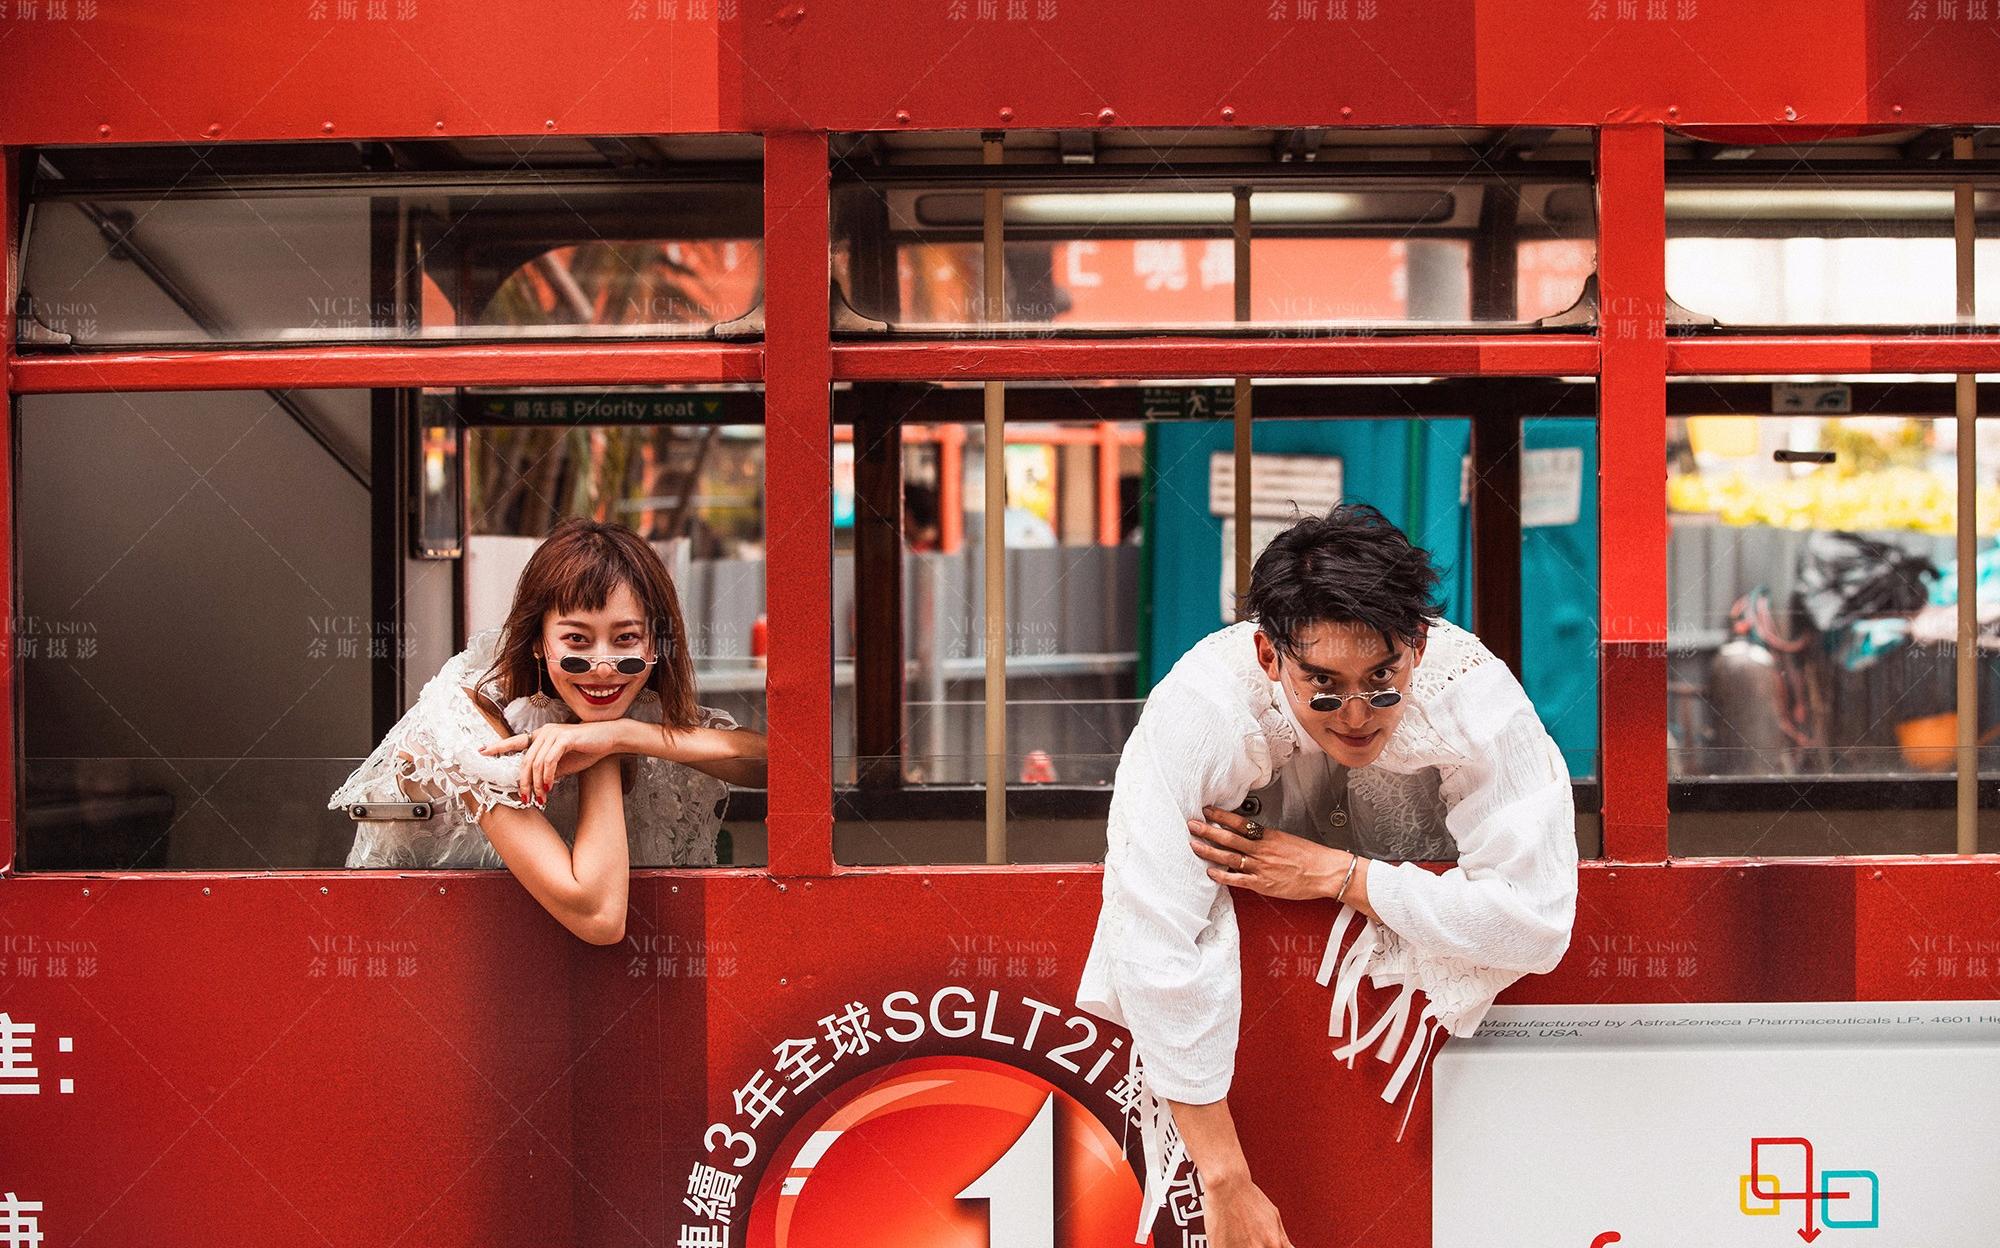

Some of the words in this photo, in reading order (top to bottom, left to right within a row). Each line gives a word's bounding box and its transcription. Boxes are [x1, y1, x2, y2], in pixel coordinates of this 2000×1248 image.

[574, 400, 647, 419] Priority
[653, 402, 695, 417] seat
[1479, 1019, 1600, 1028] Manufactured
[1605, 1019, 1631, 1028] by
[1630, 1018, 1741, 1027] AstraZeneca
[1747, 1016, 1891, 1026] Pharmaceuticals
[1930, 1016, 1972, 1024] 4601
[1539, 1029, 1583, 1038] USA.
